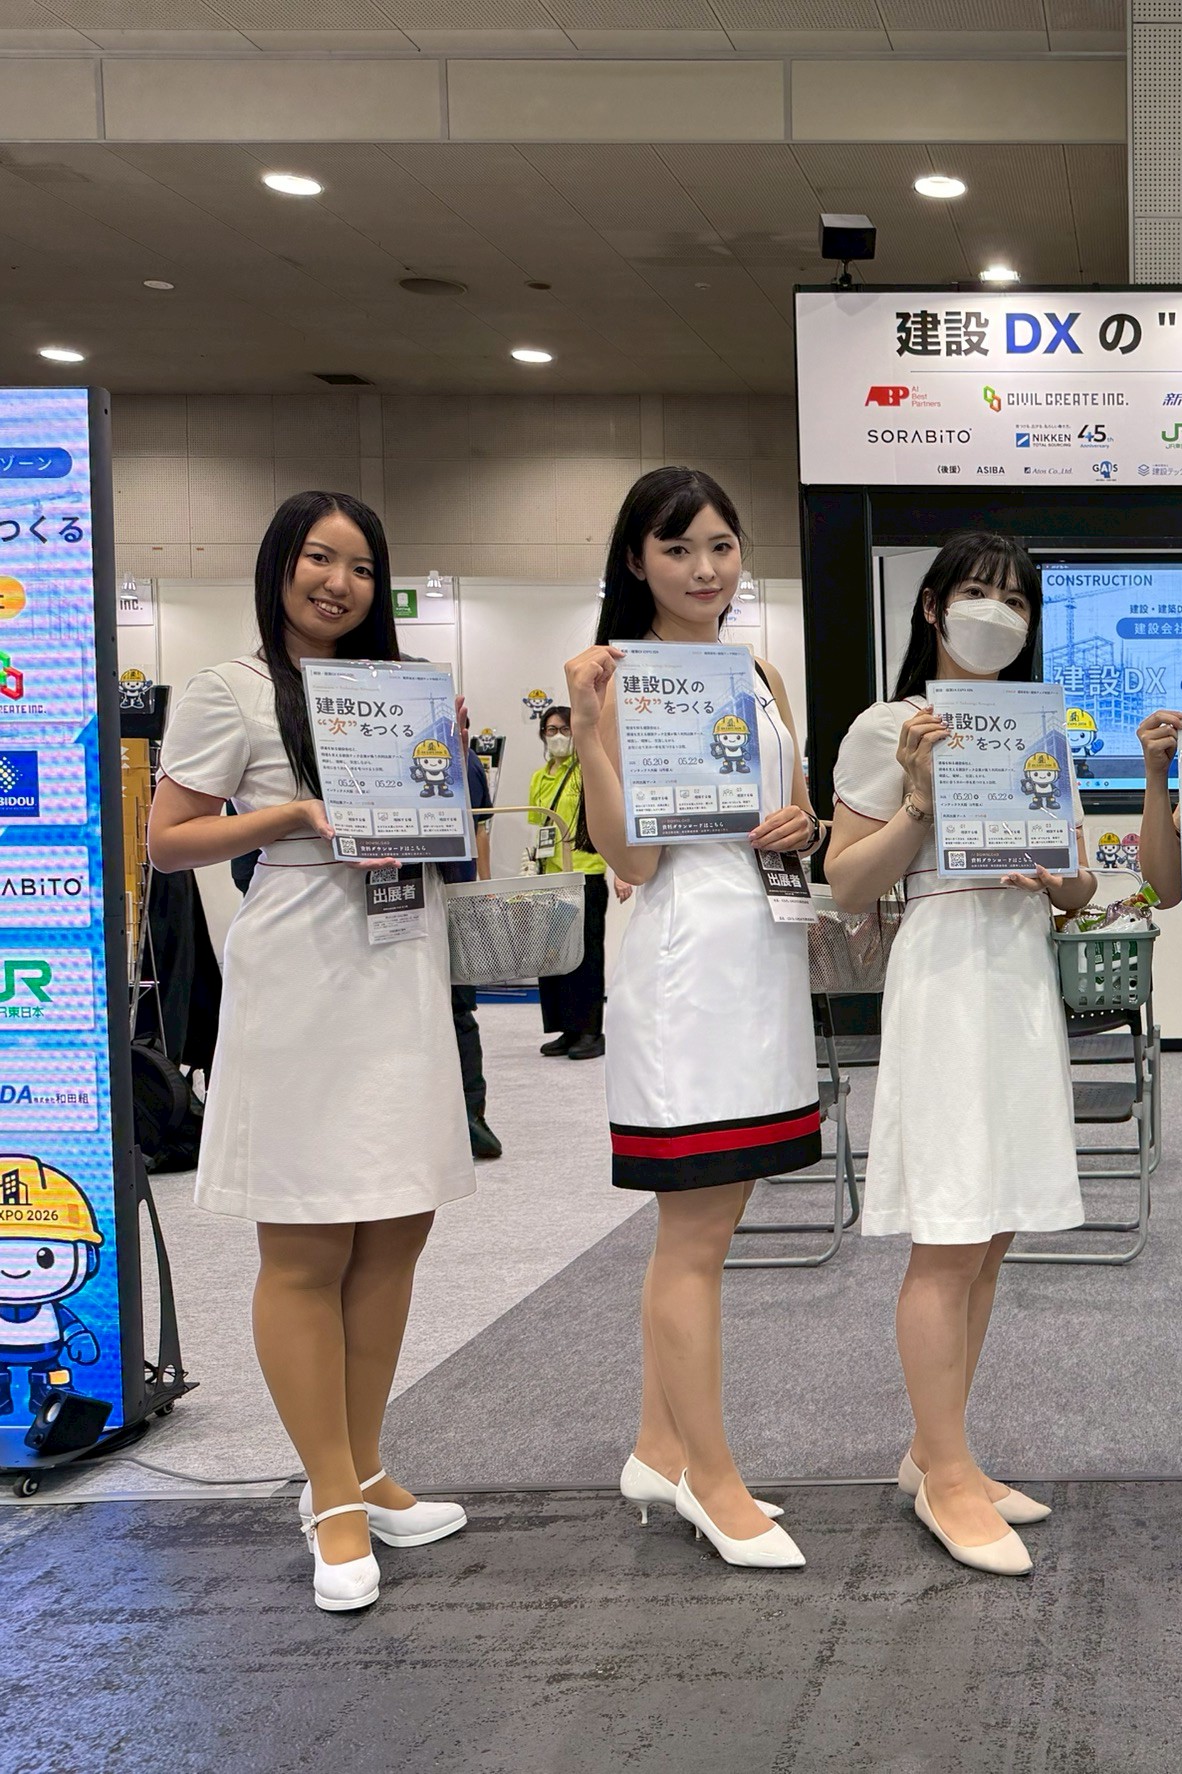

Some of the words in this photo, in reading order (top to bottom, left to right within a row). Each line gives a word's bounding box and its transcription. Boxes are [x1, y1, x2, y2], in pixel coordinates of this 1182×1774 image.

[1005, 312, 1083, 354] DX
[1007, 393, 1042, 405] CIVIL
[1045, 393, 1099, 405] CREATE
[1033, 434, 1071, 442] NIKKEN
[977, 466, 1005, 474] ASIBA
[0, 515, 83, 543] つくる
[1047, 574, 1153, 587] CONSTRUCTION
[622, 675, 705, 695] 建設DXの
[315, 697, 403, 718] 建設DXの
[947, 733, 1025, 751] 次”をつくる
[767, 872, 802, 888] 出展者
[373, 884, 416, 905] 出展者
[27, 1210, 58, 1220] 2026
